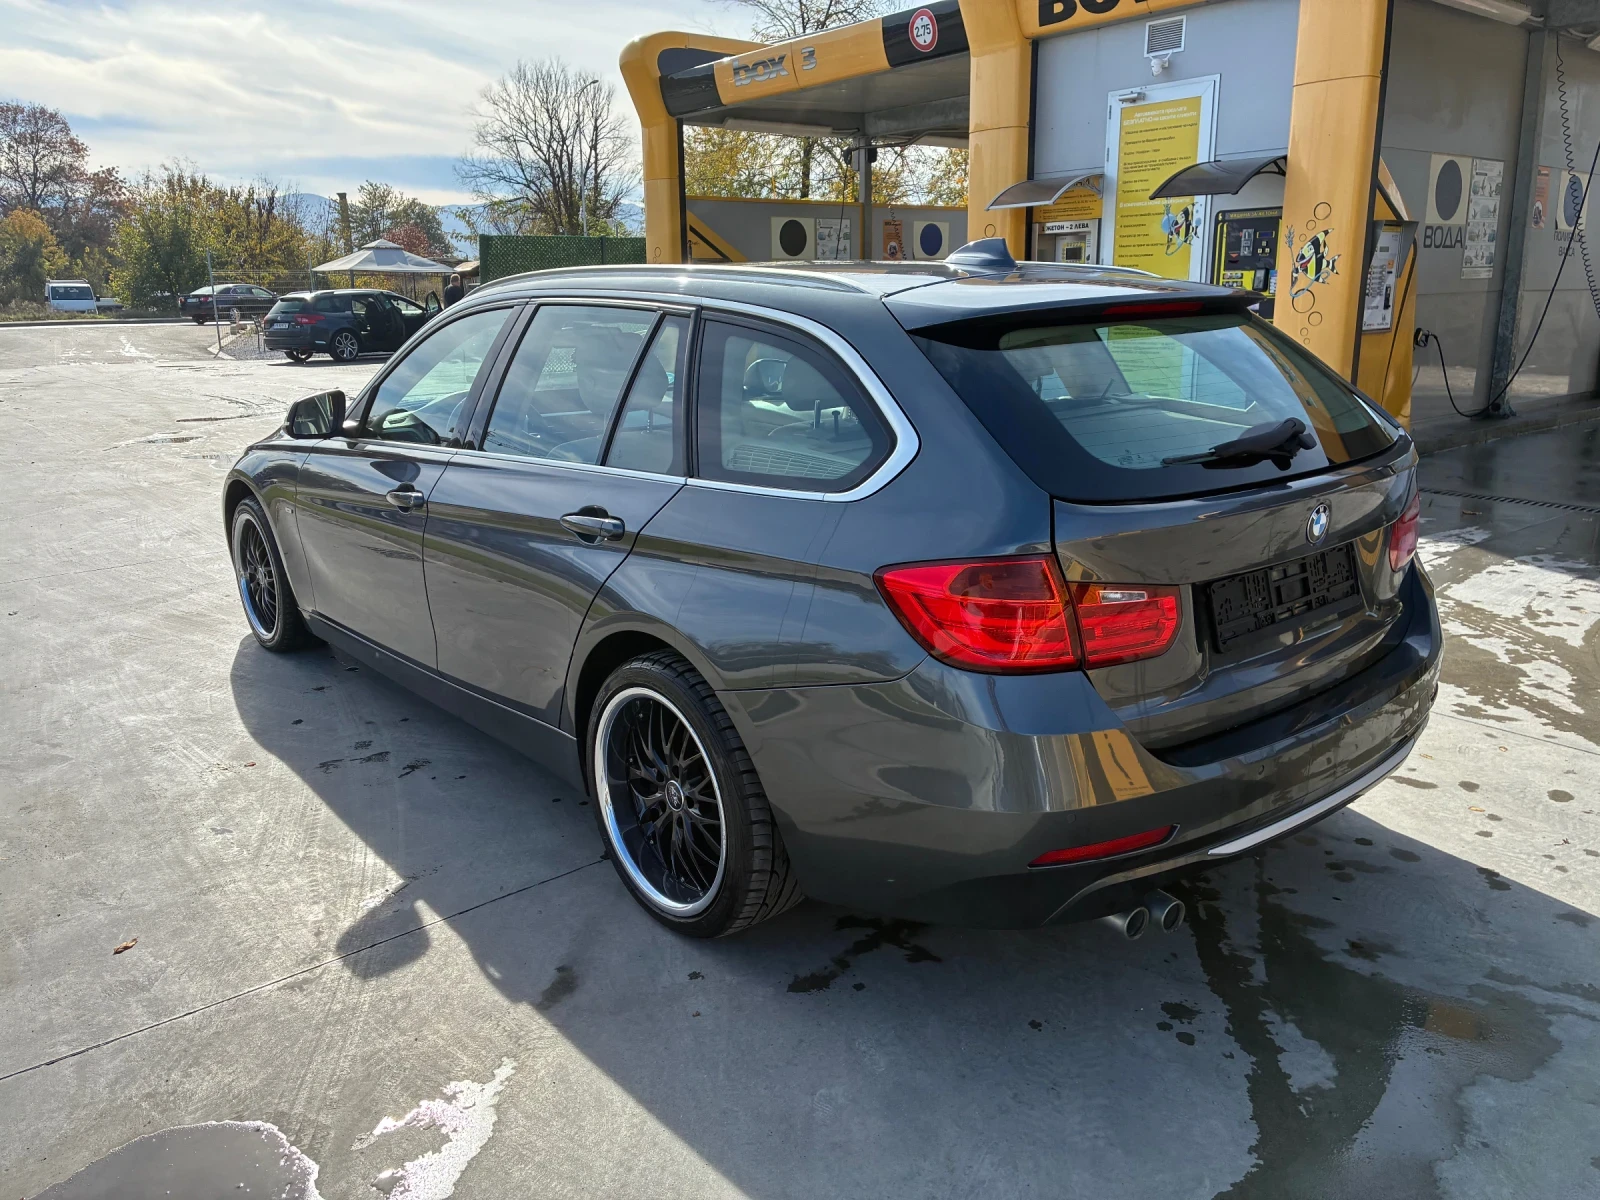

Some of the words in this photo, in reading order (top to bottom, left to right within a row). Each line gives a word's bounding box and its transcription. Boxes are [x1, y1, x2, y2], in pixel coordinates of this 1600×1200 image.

[915, 23, 932, 38] 2.75
[732, 54, 789, 87] box
[801, 46, 818, 71] 3
[1423, 225, 1463, 249] ВОДА
